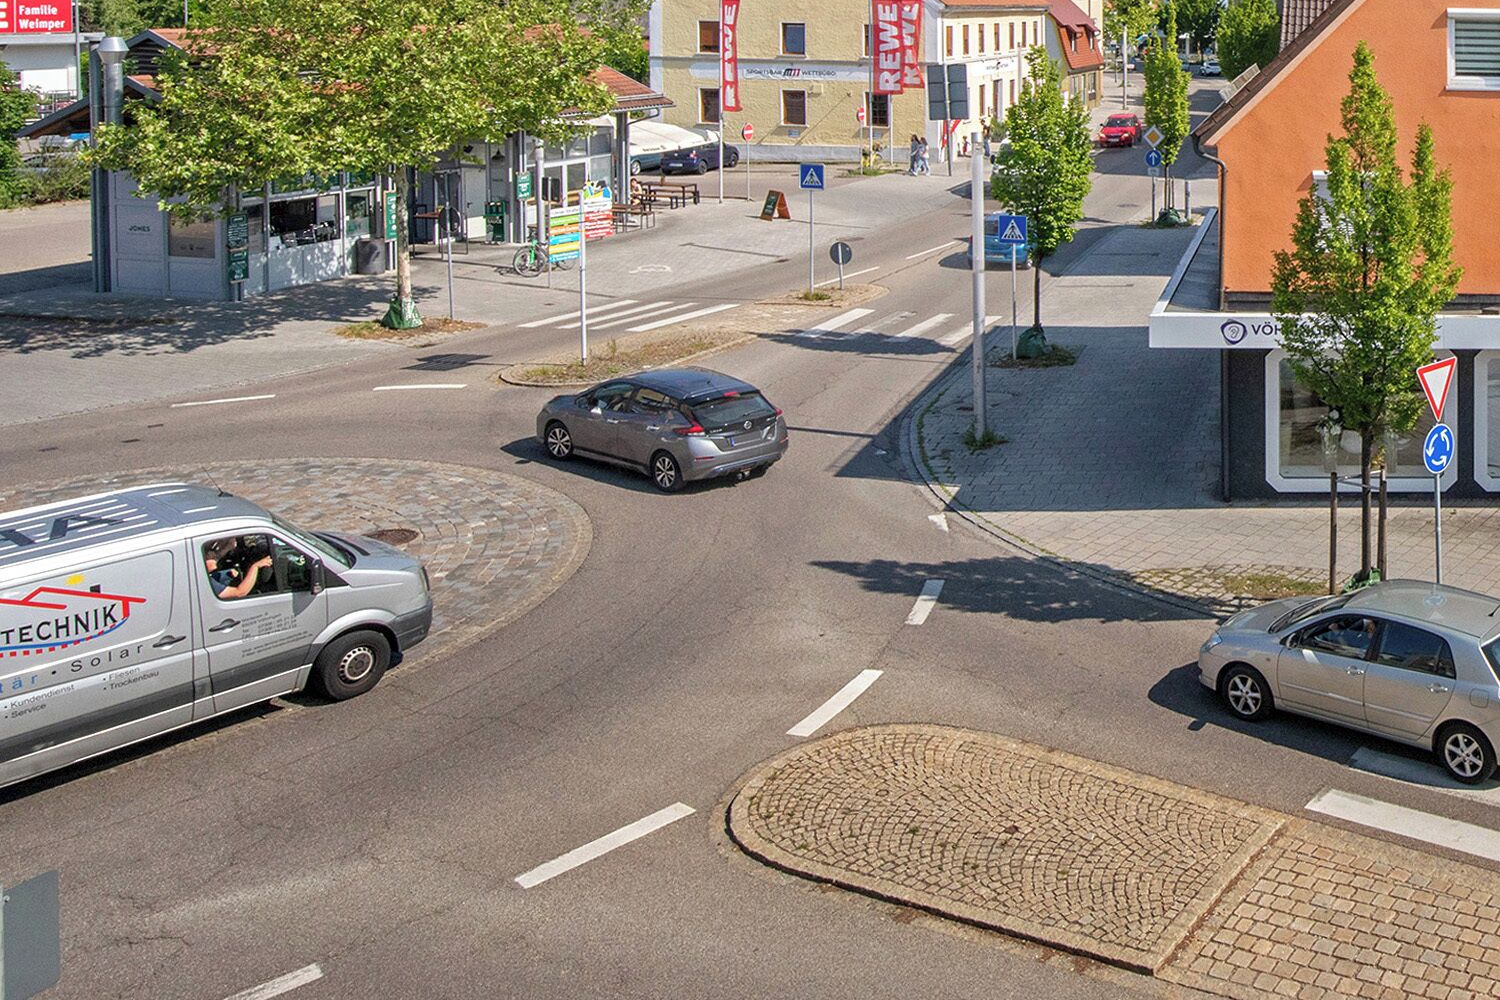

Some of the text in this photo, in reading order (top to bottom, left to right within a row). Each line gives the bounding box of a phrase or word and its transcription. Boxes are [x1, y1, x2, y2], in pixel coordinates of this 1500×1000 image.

[18, 4, 58, 15] Familie
[18, 18, 66, 31] Weimper
[877, 3, 901, 91] REWE
[1, 603, 118, 645] TECHNIK
[70, 643, 144, 673] Solar
[108, 666, 141, 681] Fliesen
[109, 670, 160, 691] Trockenbau
[10, 683, 75, 709] Kundendienst
[11, 703, 47, 719] Service
